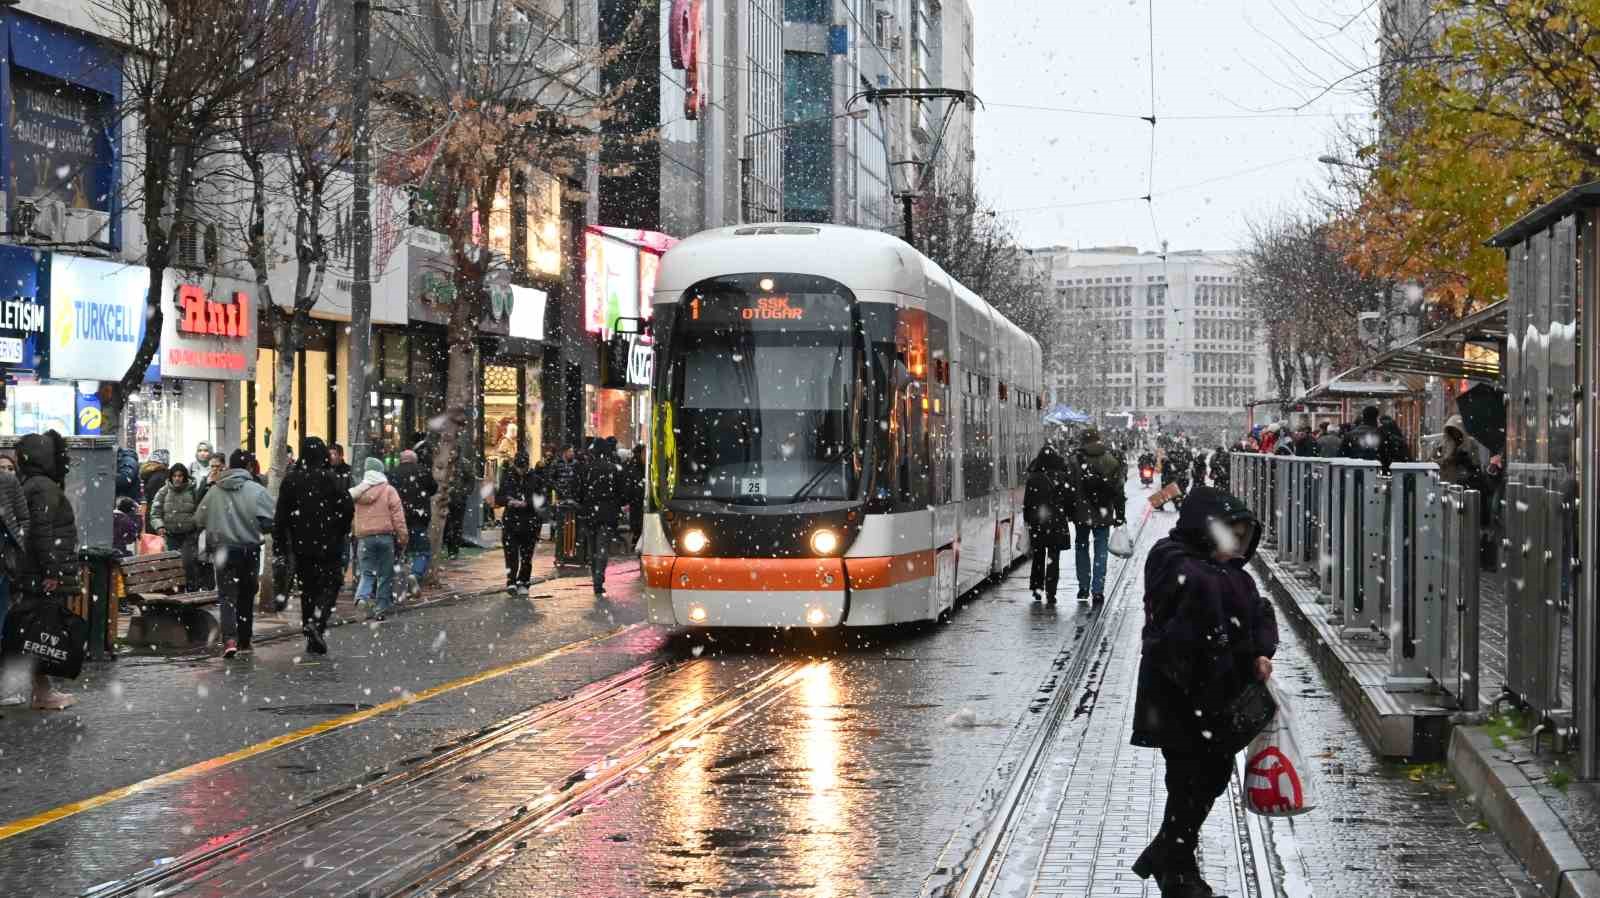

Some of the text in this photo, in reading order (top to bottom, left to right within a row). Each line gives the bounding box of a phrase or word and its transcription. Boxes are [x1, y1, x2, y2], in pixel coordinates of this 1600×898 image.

[690, 297, 699, 319] 1
[757, 298, 789, 308] SSK
[742, 308, 802, 319] OTOGAR
[74, 301, 135, 342] TURKCELL
[749, 482, 760, 493] 25
